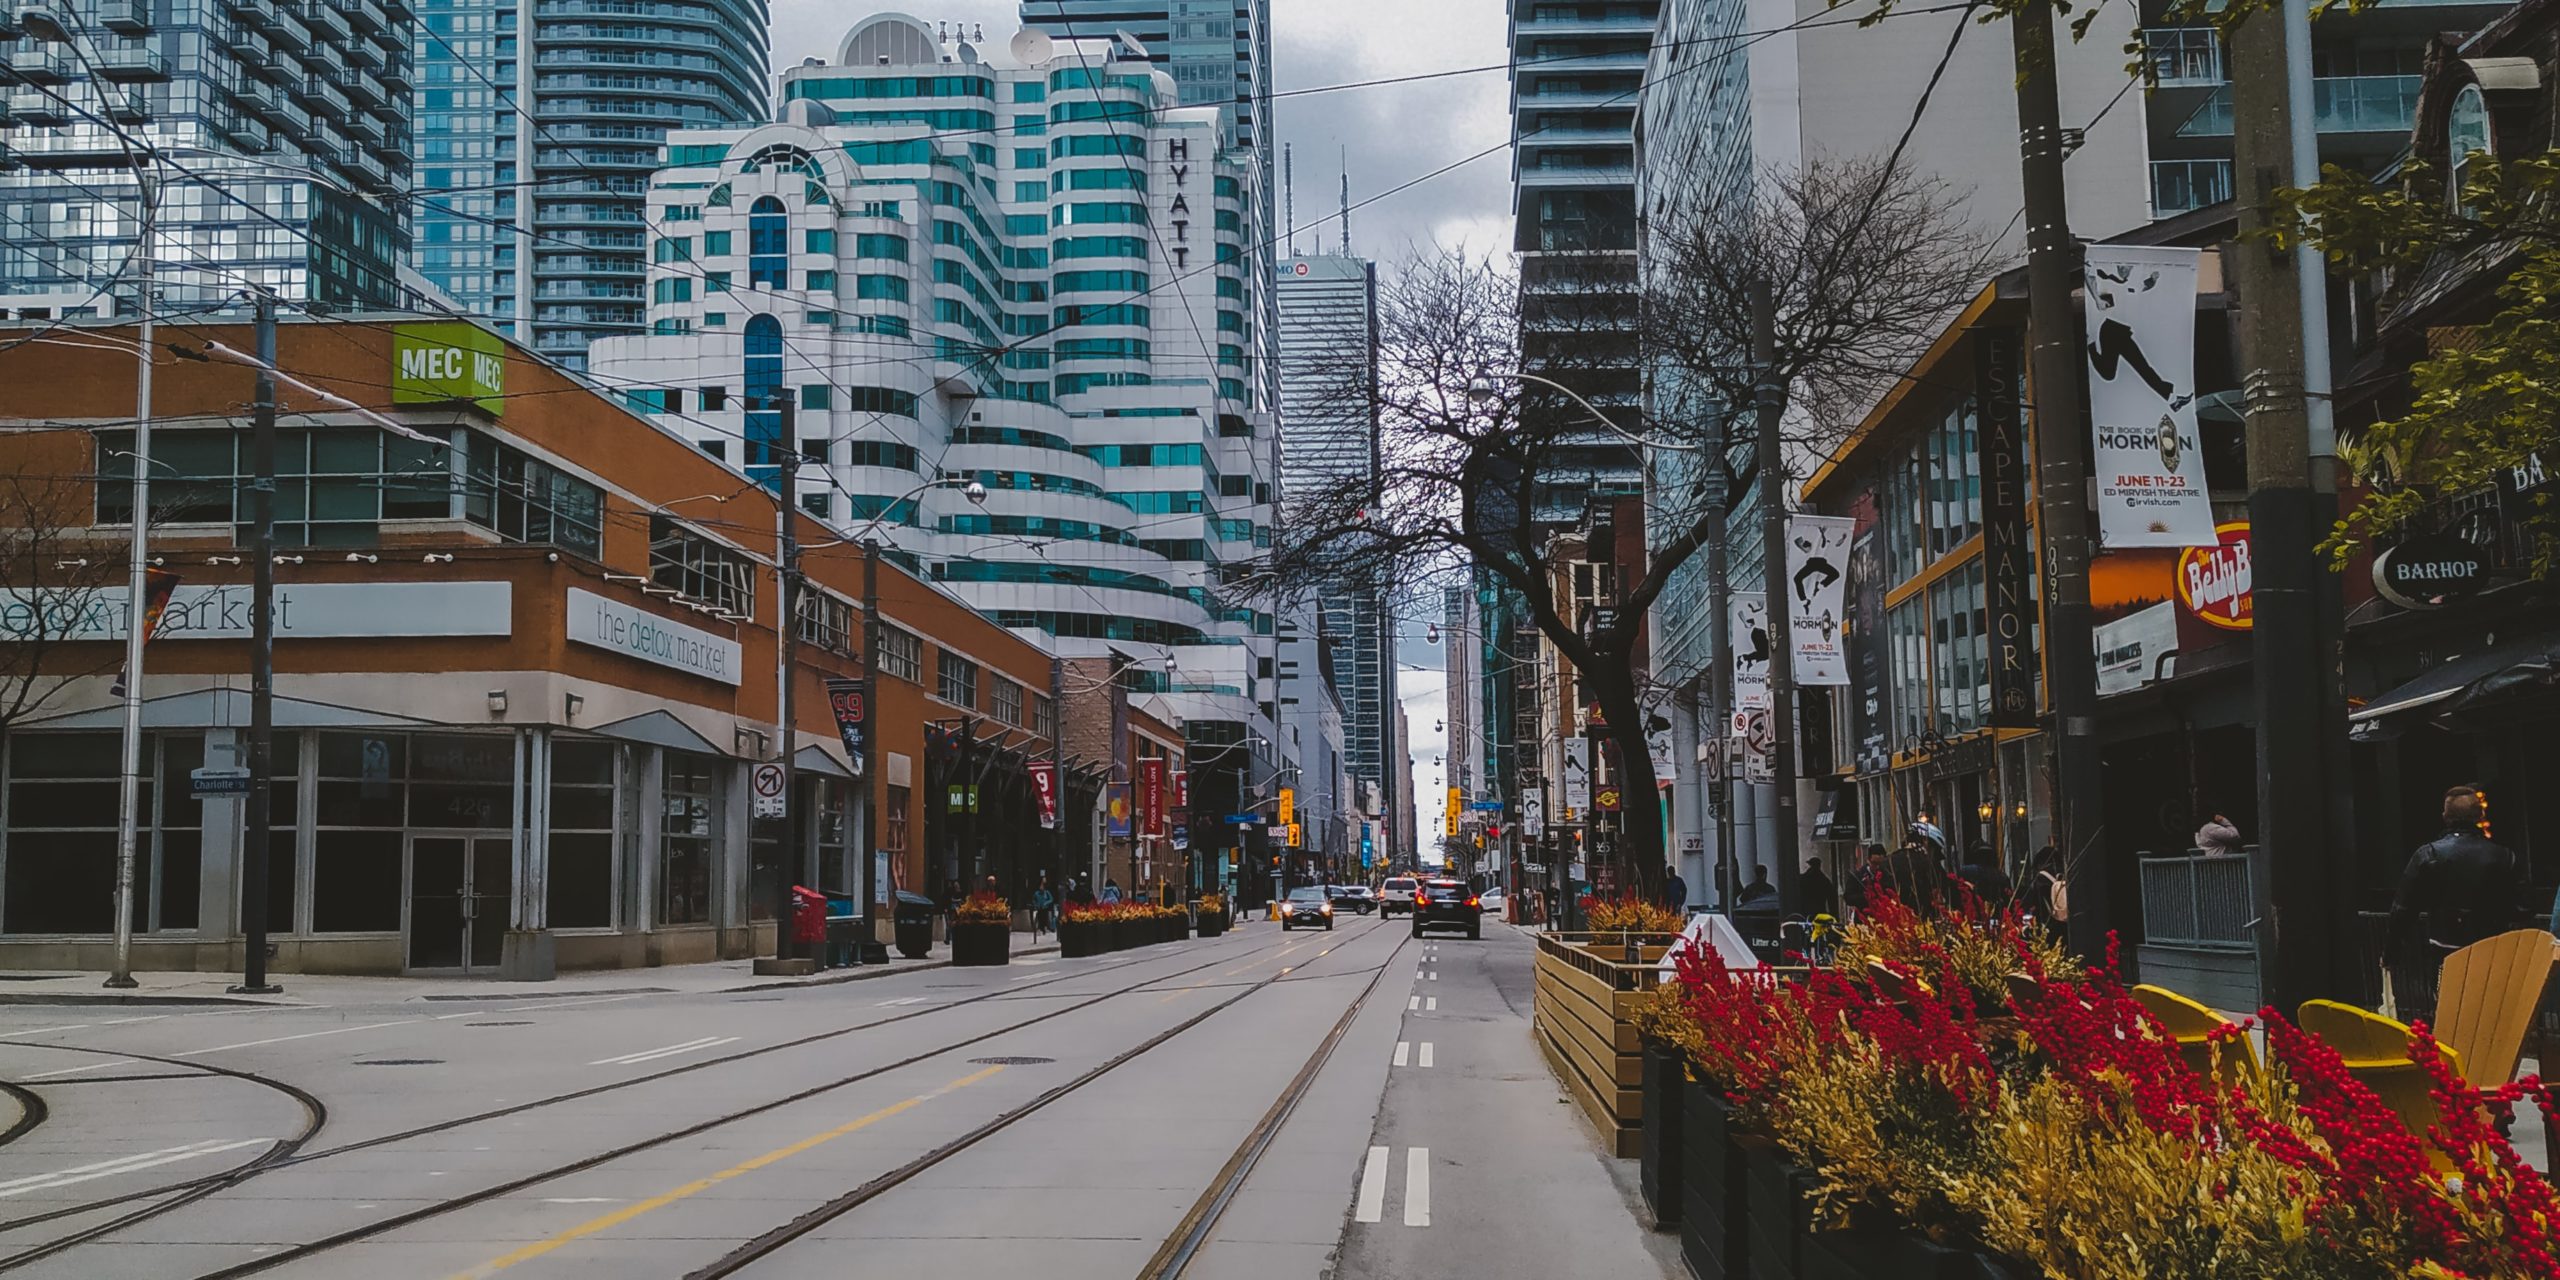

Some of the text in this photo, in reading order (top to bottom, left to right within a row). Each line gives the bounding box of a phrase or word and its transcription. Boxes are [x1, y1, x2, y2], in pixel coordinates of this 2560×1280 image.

[1169, 137, 1189, 270] HYATT
[401, 347, 463, 380] MEC
[474, 351, 501, 393] MEC
[1987, 339, 2013, 507] ESCAPE
[2099, 426, 2115, 434] THE
[2145, 427, 2156, 435] OF
[2099, 434, 2193, 451] MORMON
[2115, 475, 2186, 487] JUNE 11-23
[2512, 452, 2549, 493] BA
[2104, 488, 2200, 497] ED MIRVISH THEATRE
[2187, 539, 2252, 618] BellyB
[2396, 560, 2479, 580] BARHOP
[1994, 520, 2022, 671] MANOR
[4, 603, 104, 633] eox
[597, 602, 726, 676] the detox market
[833, 693, 864, 722] 99
[194, 779, 234, 790] Charlotte
[1036, 771, 1049, 792] 9
[950, 792, 975, 806] MC
[1687, 839, 1703, 849] 37
[1752, 937, 1769, 947] Litter
